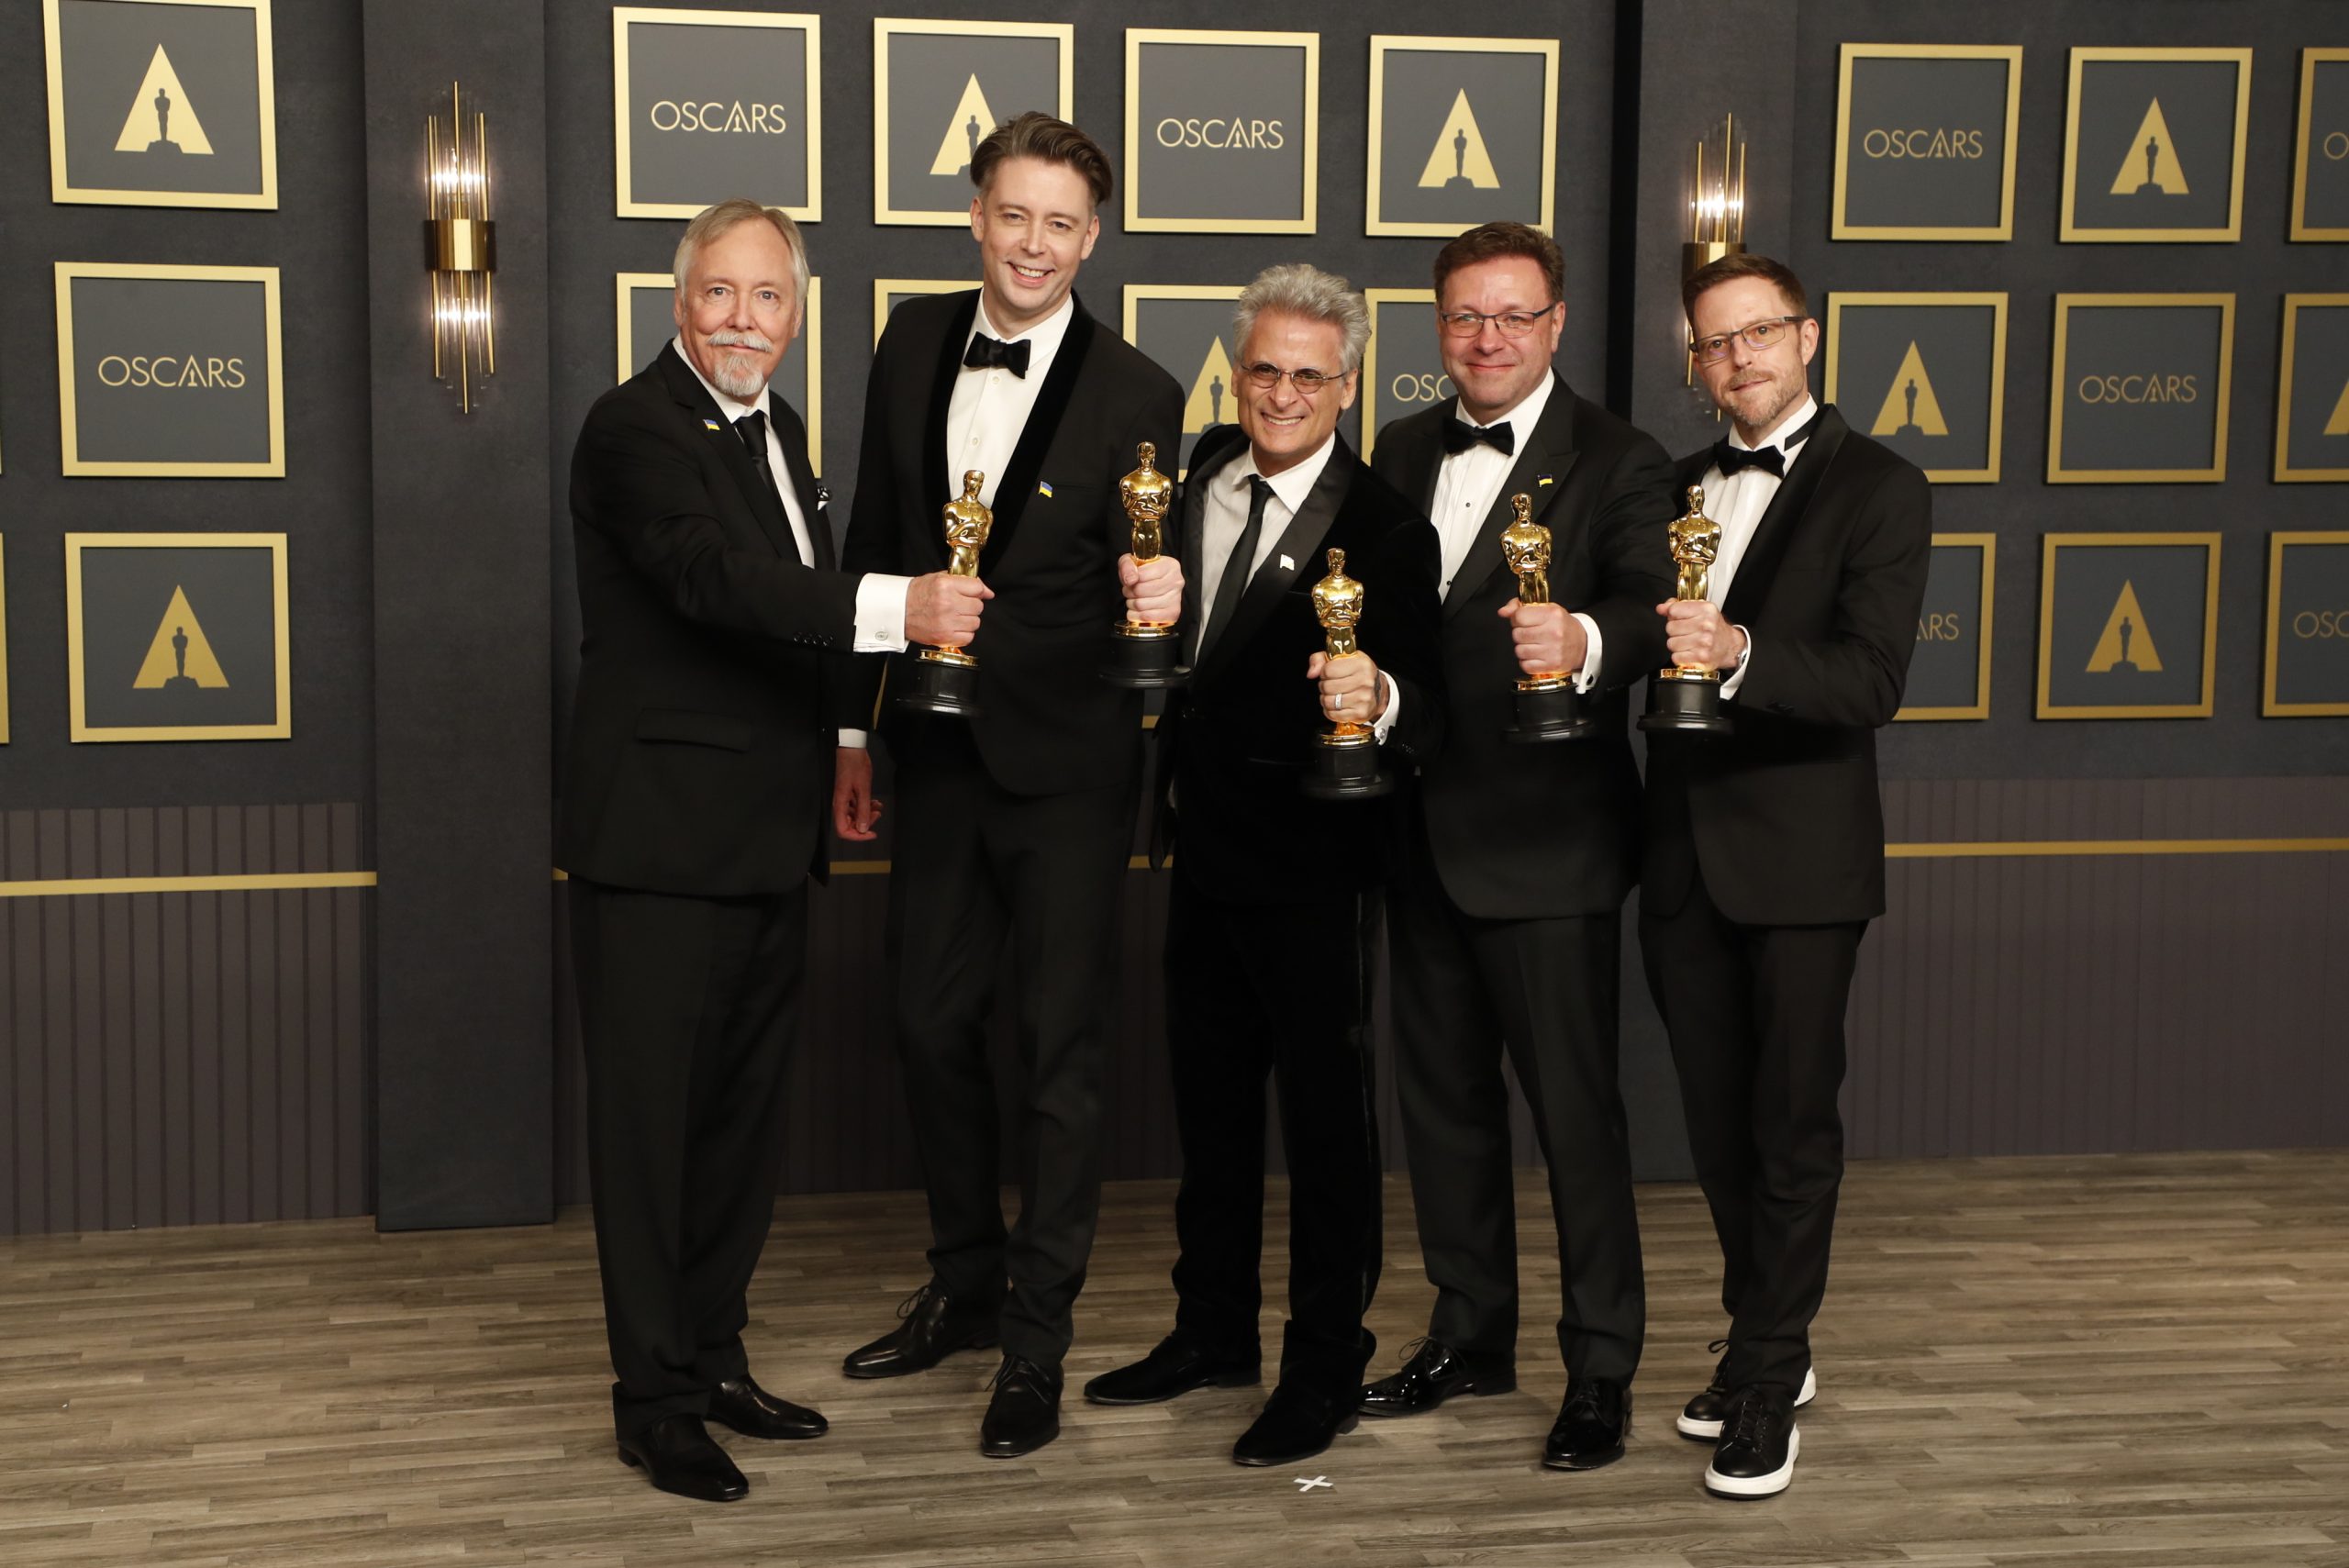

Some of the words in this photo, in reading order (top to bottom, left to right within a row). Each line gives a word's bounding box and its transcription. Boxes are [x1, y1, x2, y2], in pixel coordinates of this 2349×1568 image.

[651, 100, 787, 133] OSCARS
[1156, 117, 1285, 149] OSCARS
[1864, 128, 1984, 159] OSCARS
[97, 354, 247, 389] OSCARS
[2079, 375, 2198, 404] OSCARS
